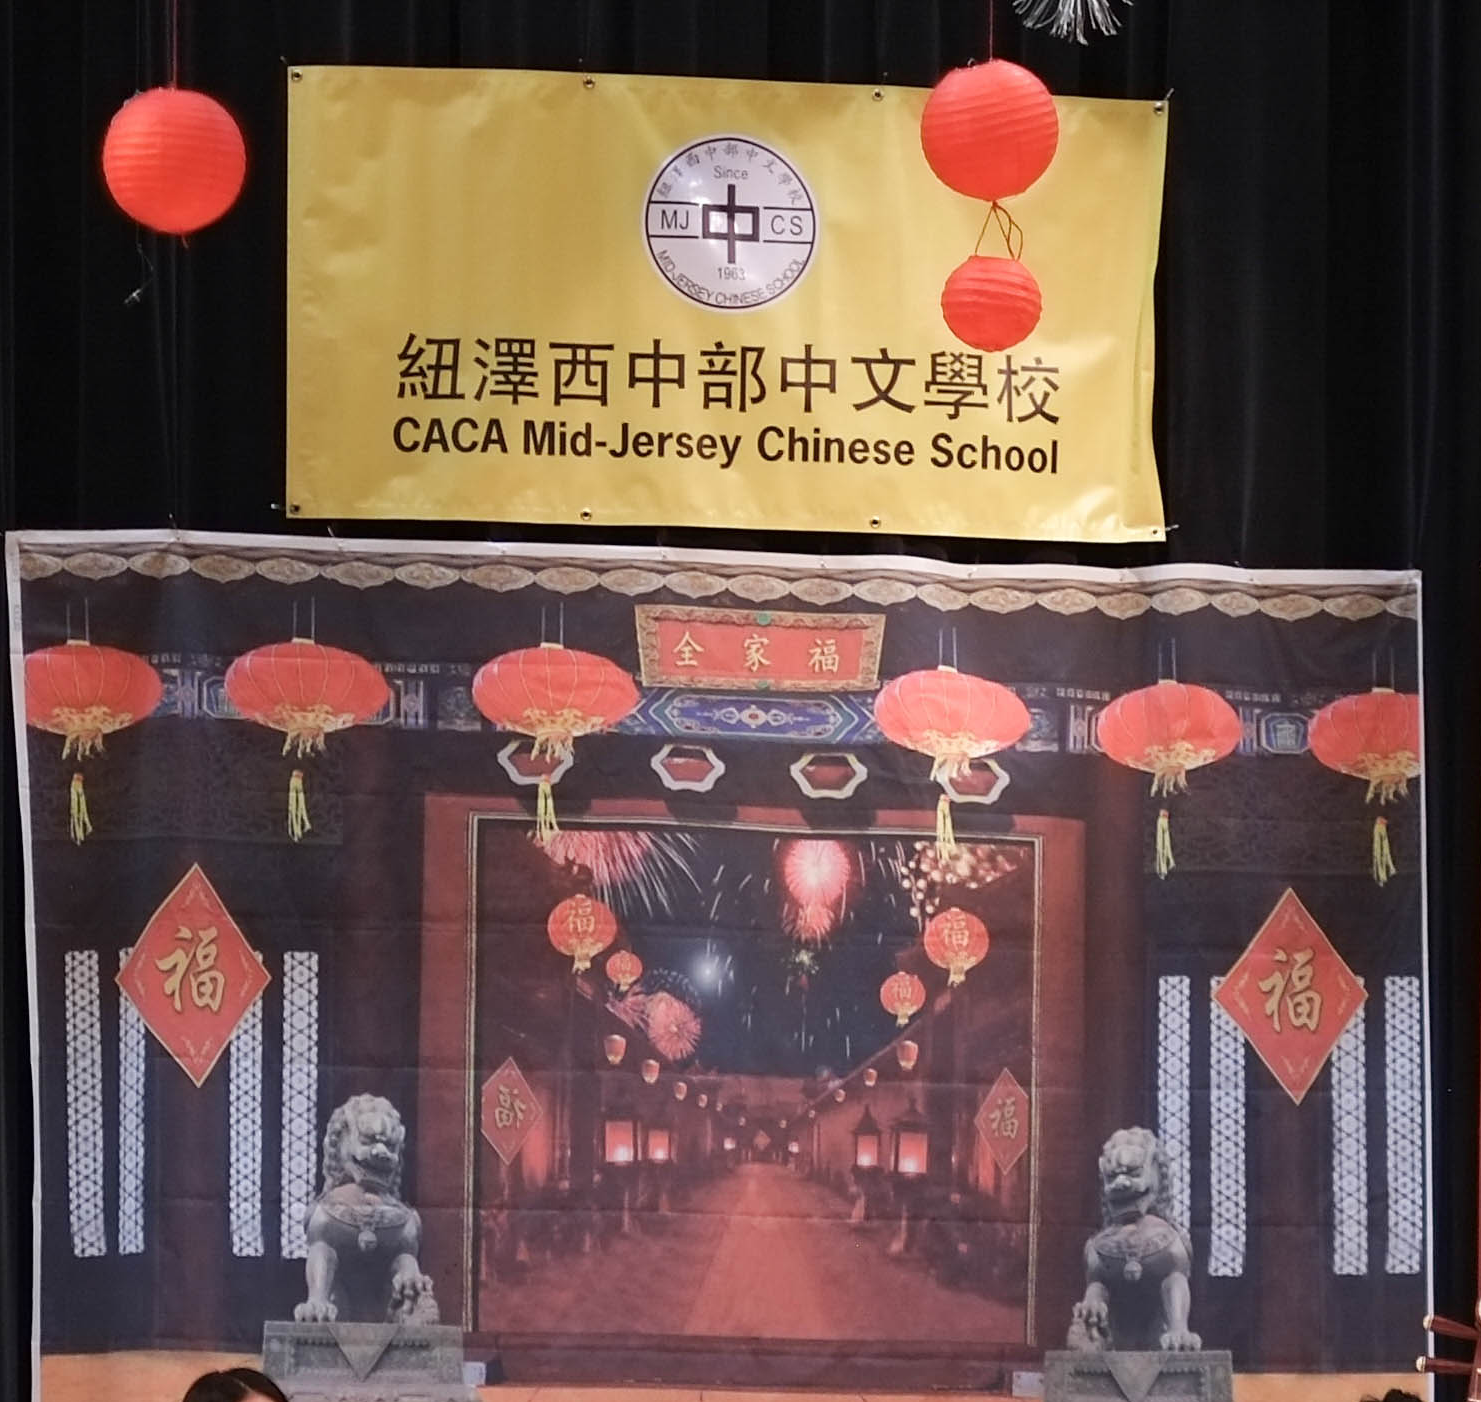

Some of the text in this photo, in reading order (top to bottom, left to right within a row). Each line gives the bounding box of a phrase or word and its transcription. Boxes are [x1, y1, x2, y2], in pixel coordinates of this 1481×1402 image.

[713, 165, 749, 180] Since
[660, 209, 689, 230] MJ
[770, 214, 804, 236] CS
[714, 289, 768, 305] CHINESE
[765, 258, 806, 296] SCHOOL
[396, 332, 1061, 425] 紐澤西中部中文學校
[392, 416, 1059, 475] CACA Mid-Jersey Chinese School
[673, 631, 840, 674] 全家福
[154, 925, 226, 1014] 福
[1258, 948, 1323, 1034] 福
